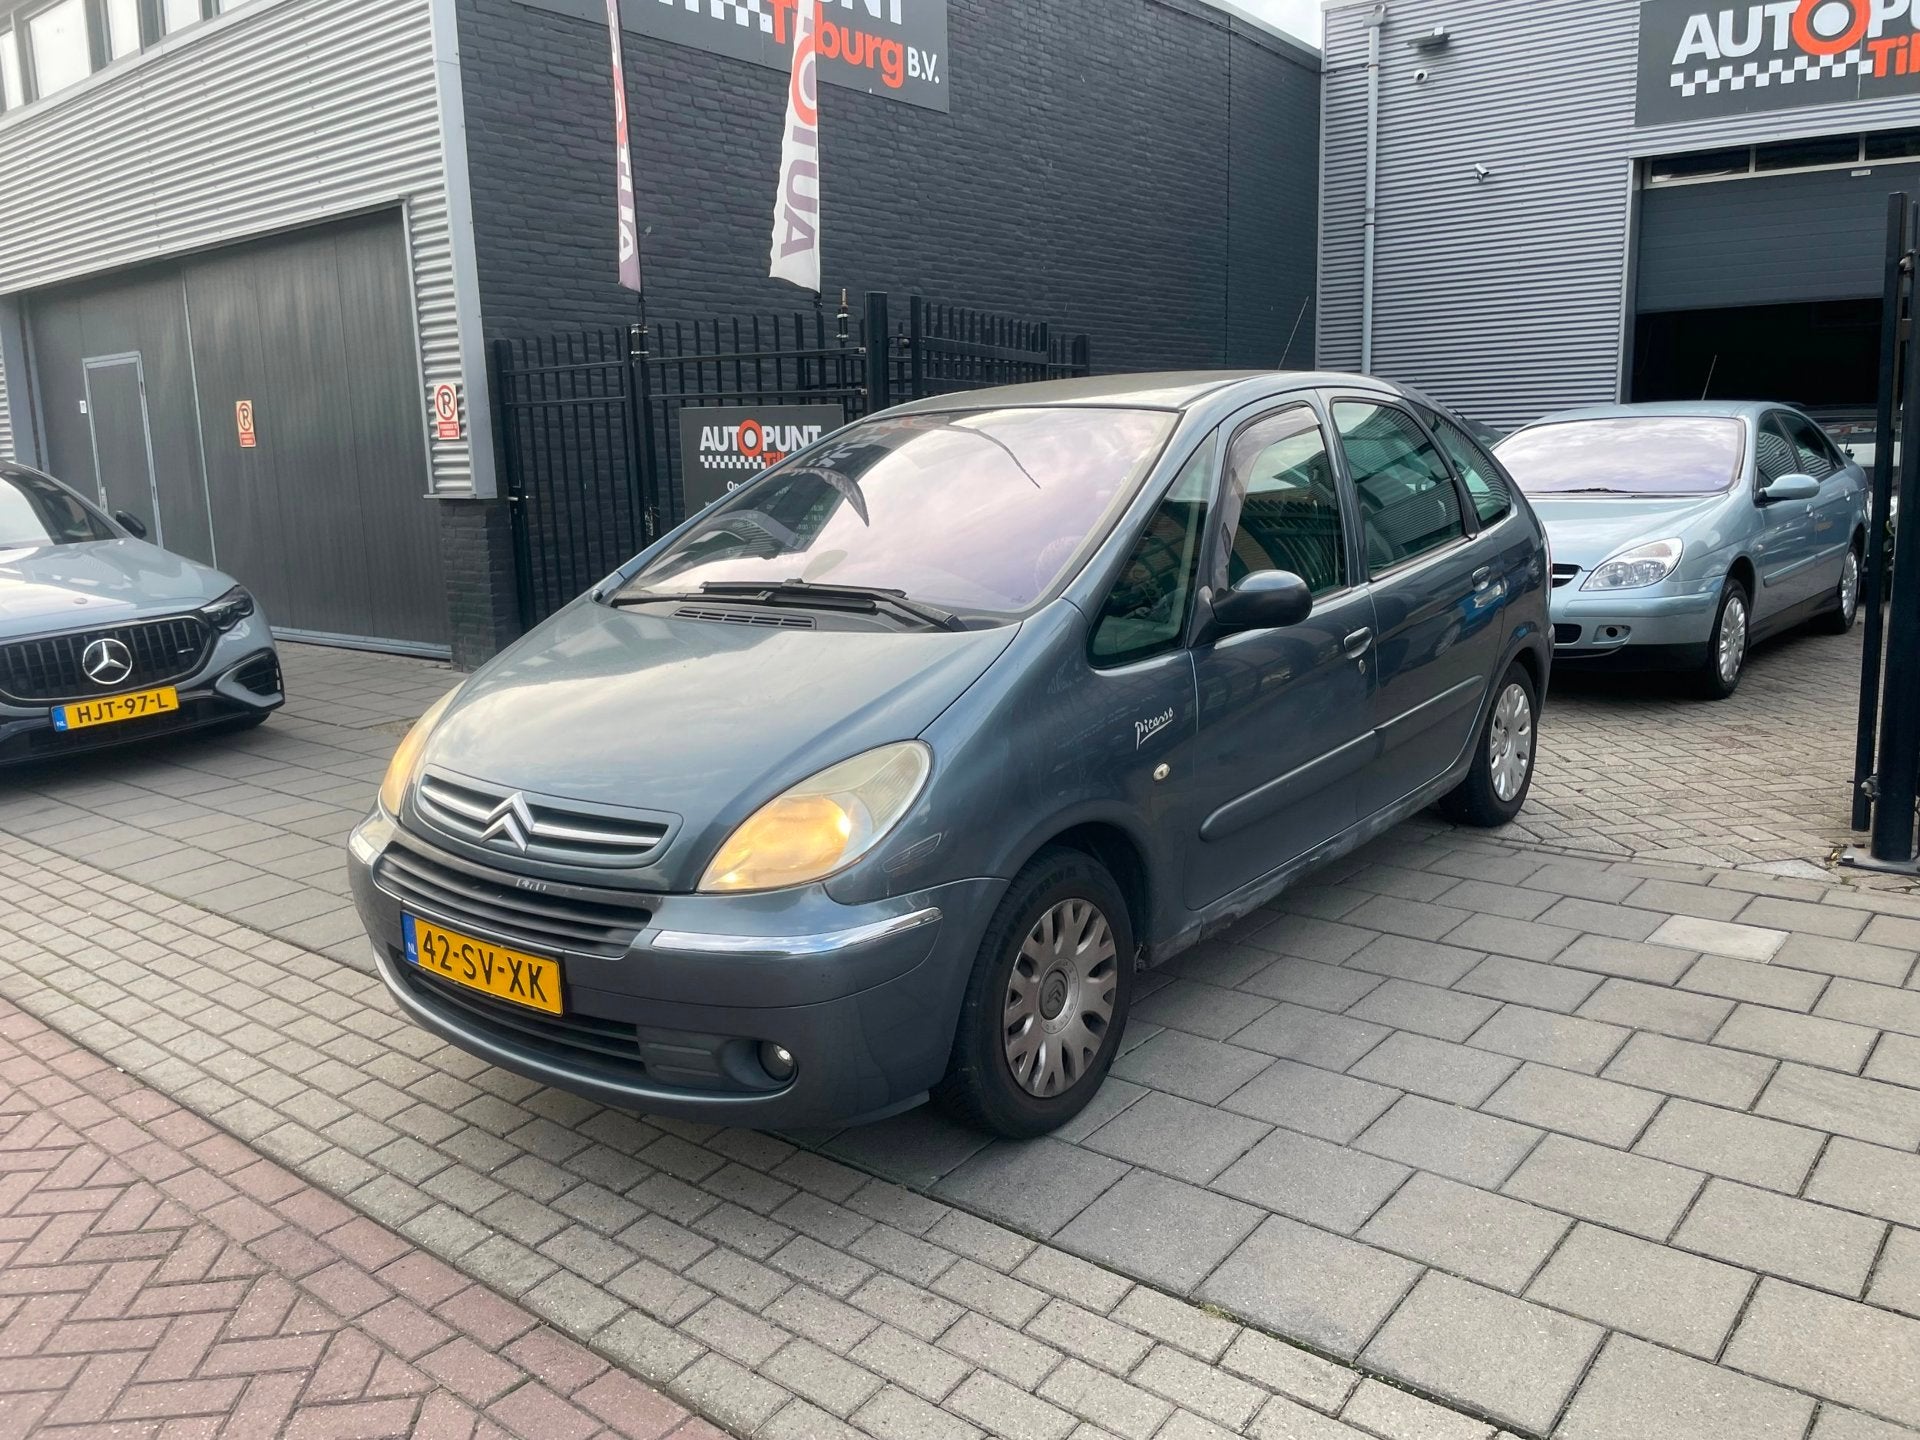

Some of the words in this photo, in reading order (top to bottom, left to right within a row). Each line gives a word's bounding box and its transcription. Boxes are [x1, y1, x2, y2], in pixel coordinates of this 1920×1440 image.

[767, 0, 904, 88] Tburg
[907, 46, 940, 83] B.V.
[1671, 0, 1920, 65] AUTOP
[699, 418, 822, 458] AUTOPUNT
[77, 693, 169, 723] HJT-97-L
[1134, 707, 1174, 750] Picasso
[407, 942, 416, 954] NL
[422, 930, 548, 1003] 42-SV-XK
